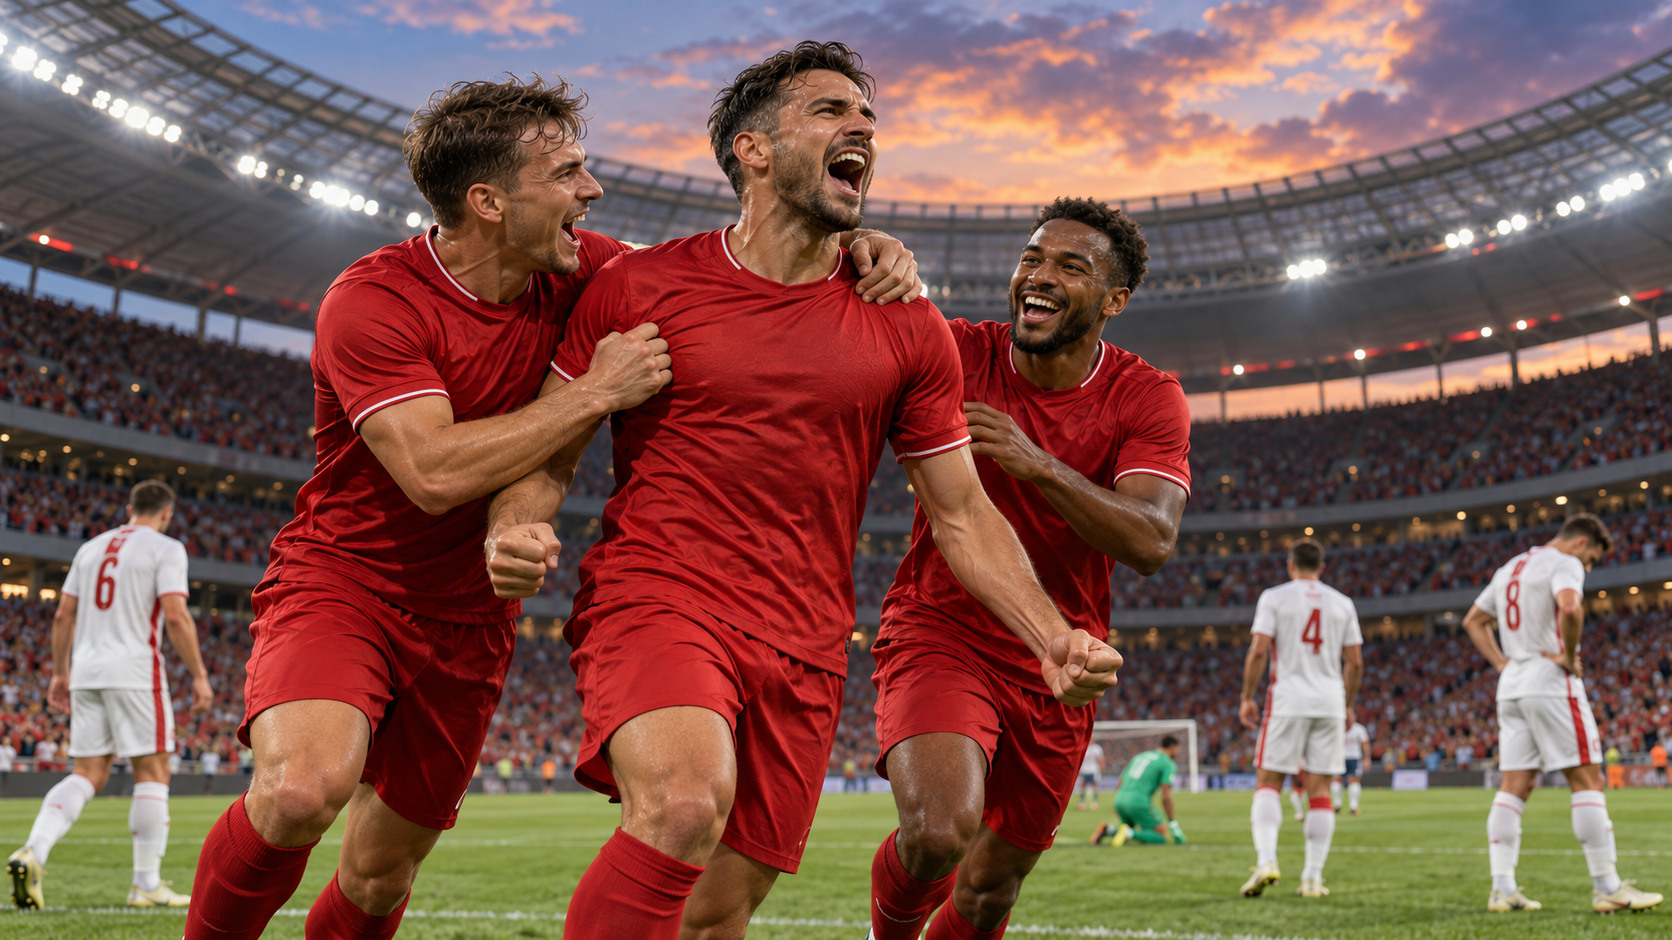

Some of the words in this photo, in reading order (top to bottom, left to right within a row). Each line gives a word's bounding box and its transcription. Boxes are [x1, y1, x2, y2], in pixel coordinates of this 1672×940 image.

[95, 556, 118, 611] 6
[1506, 579, 1521, 631] 8
[1301, 607, 1323, 655] 4
